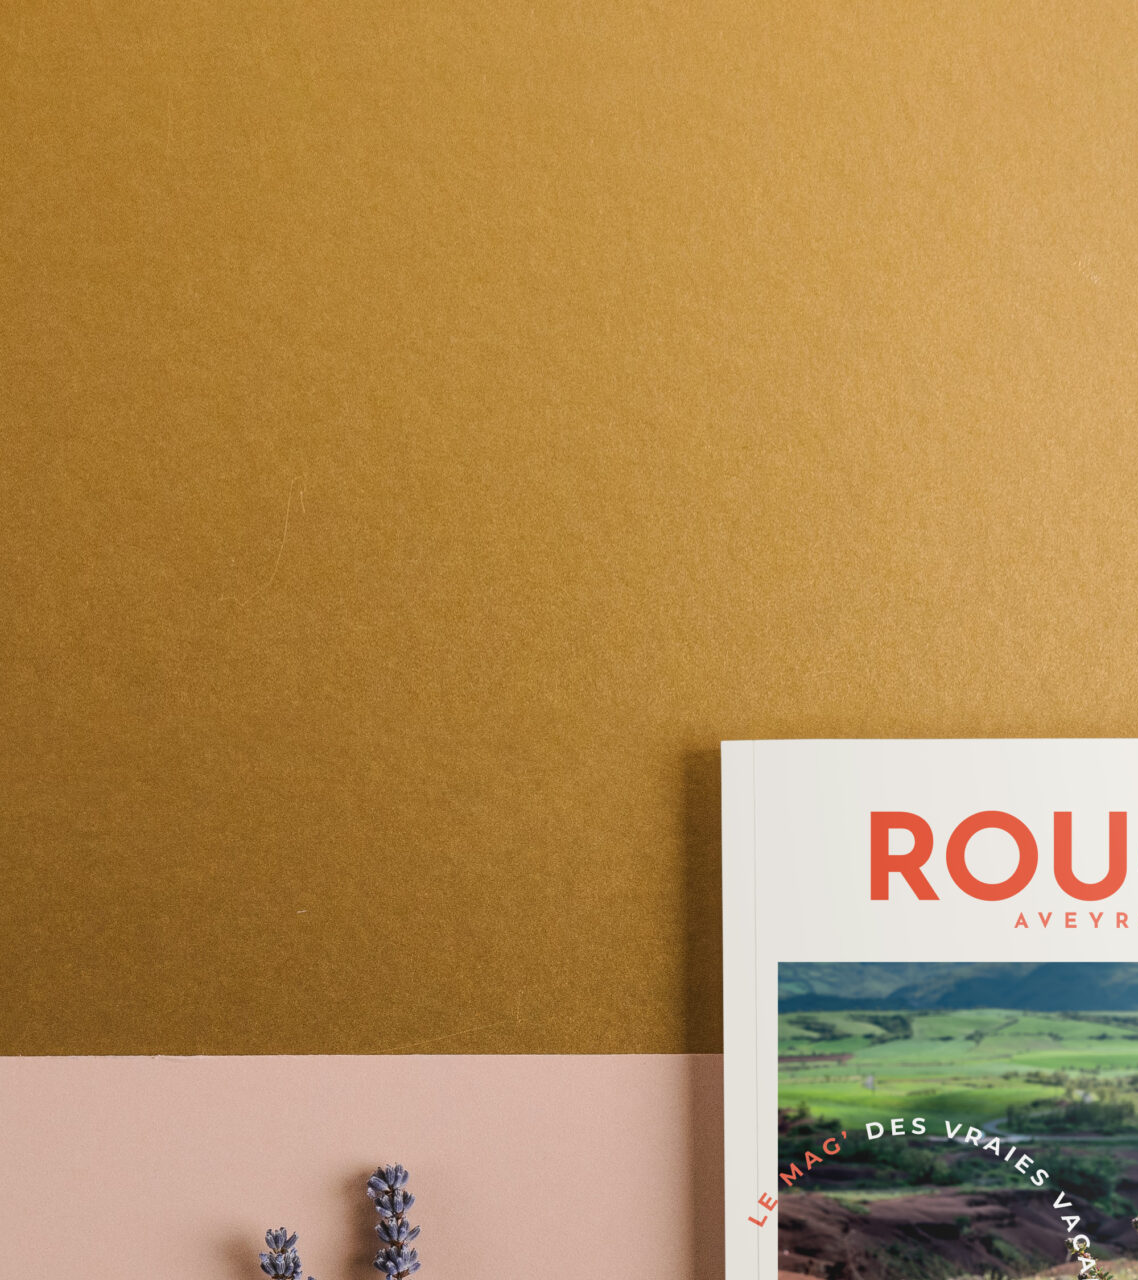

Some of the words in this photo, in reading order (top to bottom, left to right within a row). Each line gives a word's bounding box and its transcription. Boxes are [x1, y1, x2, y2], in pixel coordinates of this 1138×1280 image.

[748, 1191, 779, 1228] LE
[865, 1117, 927, 1141] DES
[944, 1119, 1050, 1187] VRAIES
